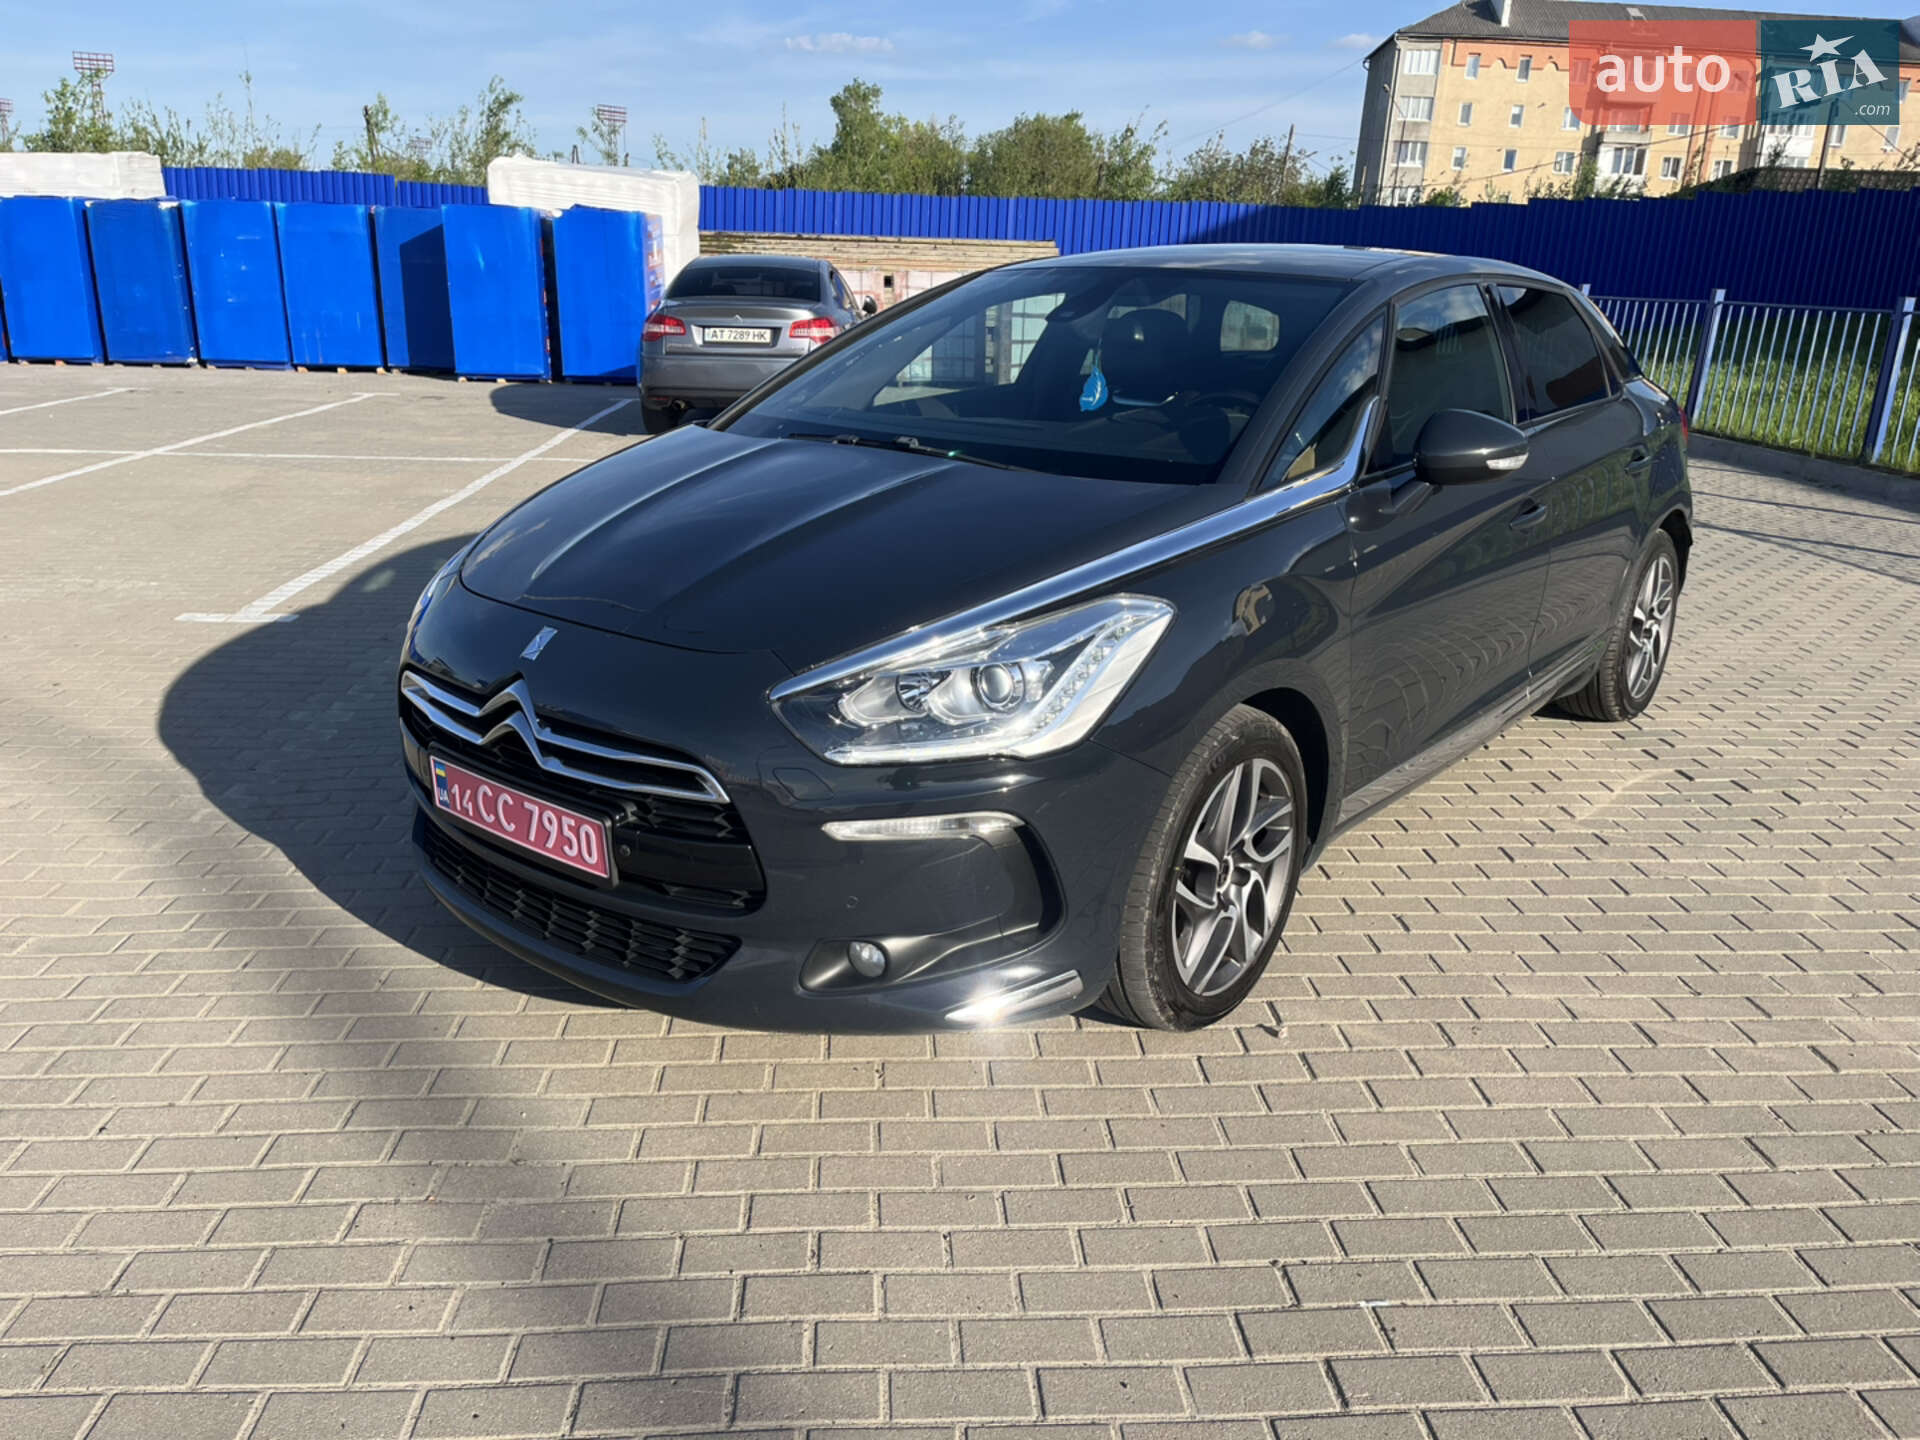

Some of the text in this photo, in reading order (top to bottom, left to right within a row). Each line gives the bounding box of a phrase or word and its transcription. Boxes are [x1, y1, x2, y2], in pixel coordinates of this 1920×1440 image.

[711, 330, 766, 341] AT 7289 HK
[439, 791, 450, 804] UA
[524, 801, 598, 865] 7950
